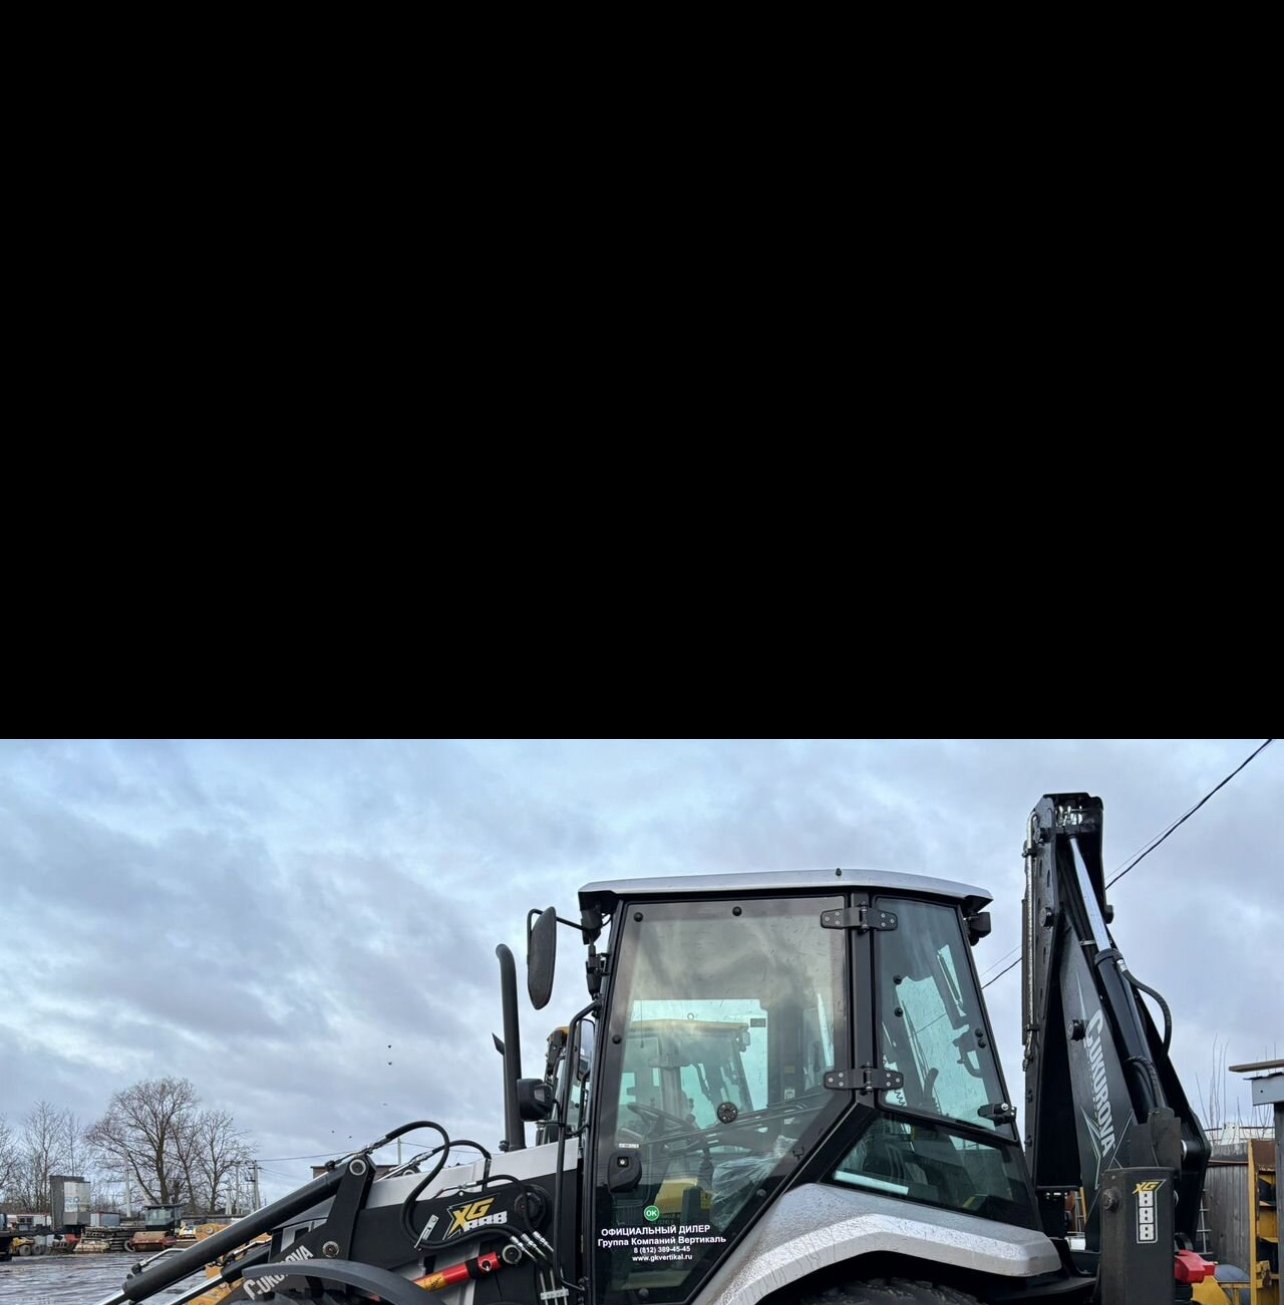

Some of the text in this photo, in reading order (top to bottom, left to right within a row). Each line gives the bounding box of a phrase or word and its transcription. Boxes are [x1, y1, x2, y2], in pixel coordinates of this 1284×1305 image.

[447, 1197, 495, 1237] XG
[1138, 1190, 1154, 1241] 888
[601, 1224, 711, 1237] ОФИЦИАЛЬНЫЙ ДИЛЕР
[598, 1235, 727, 1248] Группа Компаний Вертикаль
[633, 1245, 691, 1254] 8 (812) 389-45-45
[632, 1253, 693, 1263] www.gkvertikal.ru
